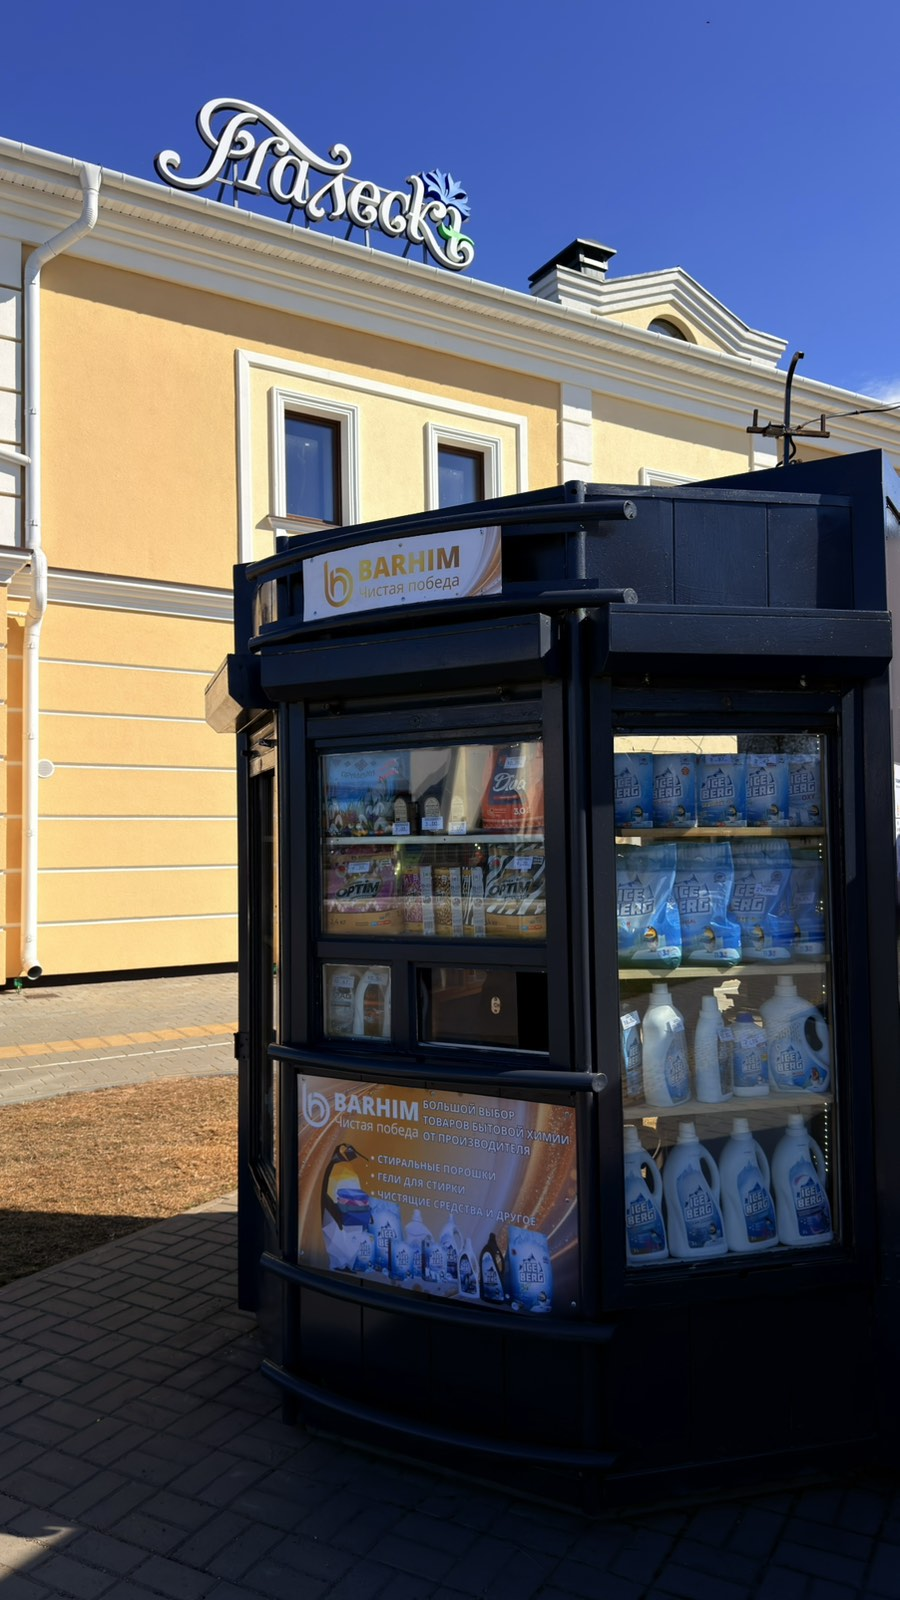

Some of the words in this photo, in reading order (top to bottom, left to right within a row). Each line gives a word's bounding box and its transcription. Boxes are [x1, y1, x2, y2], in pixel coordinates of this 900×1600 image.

[358, 545, 460, 582] BARHIM
[359, 583, 404, 599] Чистая
[408, 575, 460, 593] победа
[656, 776, 673, 788] ICE
[707, 777, 726, 788] ICE
[749, 775, 768, 787] ICE
[702, 786, 734, 800] BERG
[618, 889, 645, 903] ICE
[780, 1052, 798, 1063] ICE
[777, 1061, 804, 1073] BERG
[334, 1092, 419, 1122] BARHIM
[423, 1099, 476, 1117] БОЛЬШОЙ
[479, 1107, 515, 1120] ВЫБОР
[334, 1116, 374, 1132] Чистая
[377, 1123, 419, 1139] победа
[423, 1115, 470, 1132] ТОВАРОВ
[472, 1122, 525, 1139] БЫТОВОЙ
[526, 1131, 570, 1145] ХИМИИ
[423, 1131, 437, 1142] ОТ
[438, 1133, 531, 1156] ПРОИЗВОДИТЕЛЯ
[377, 1155, 441, 1173] СТИРАЛЬНЫЕ
[443, 1165, 497, 1181] ПОРОШКИ
[377, 1172, 401, 1185] ГЕЛИ
[403, 1176, 424, 1189] ДЛЯ
[426, 1180, 466, 1195] СТИРКИ
[801, 1185, 817, 1198] ICE
[377, 1190, 431, 1208] ЧИСТЯЩИЕ
[433, 1200, 483, 1217] СРЕДСТВА
[485, 1209, 494, 1219] И
[496, 1211, 537, 1226] ДРУГОЕ
[690, 1194, 706, 1208] ICE
[746, 1200, 769, 1215] BERG
[798, 1194, 823, 1209] BERG
[631, 1202, 647, 1216] ICE
[686, 1204, 713, 1219] BERG
[627, 1210, 655, 1225] BERG
[523, 1262, 538, 1273] ICE
[520, 1272, 544, 1283] BERG
